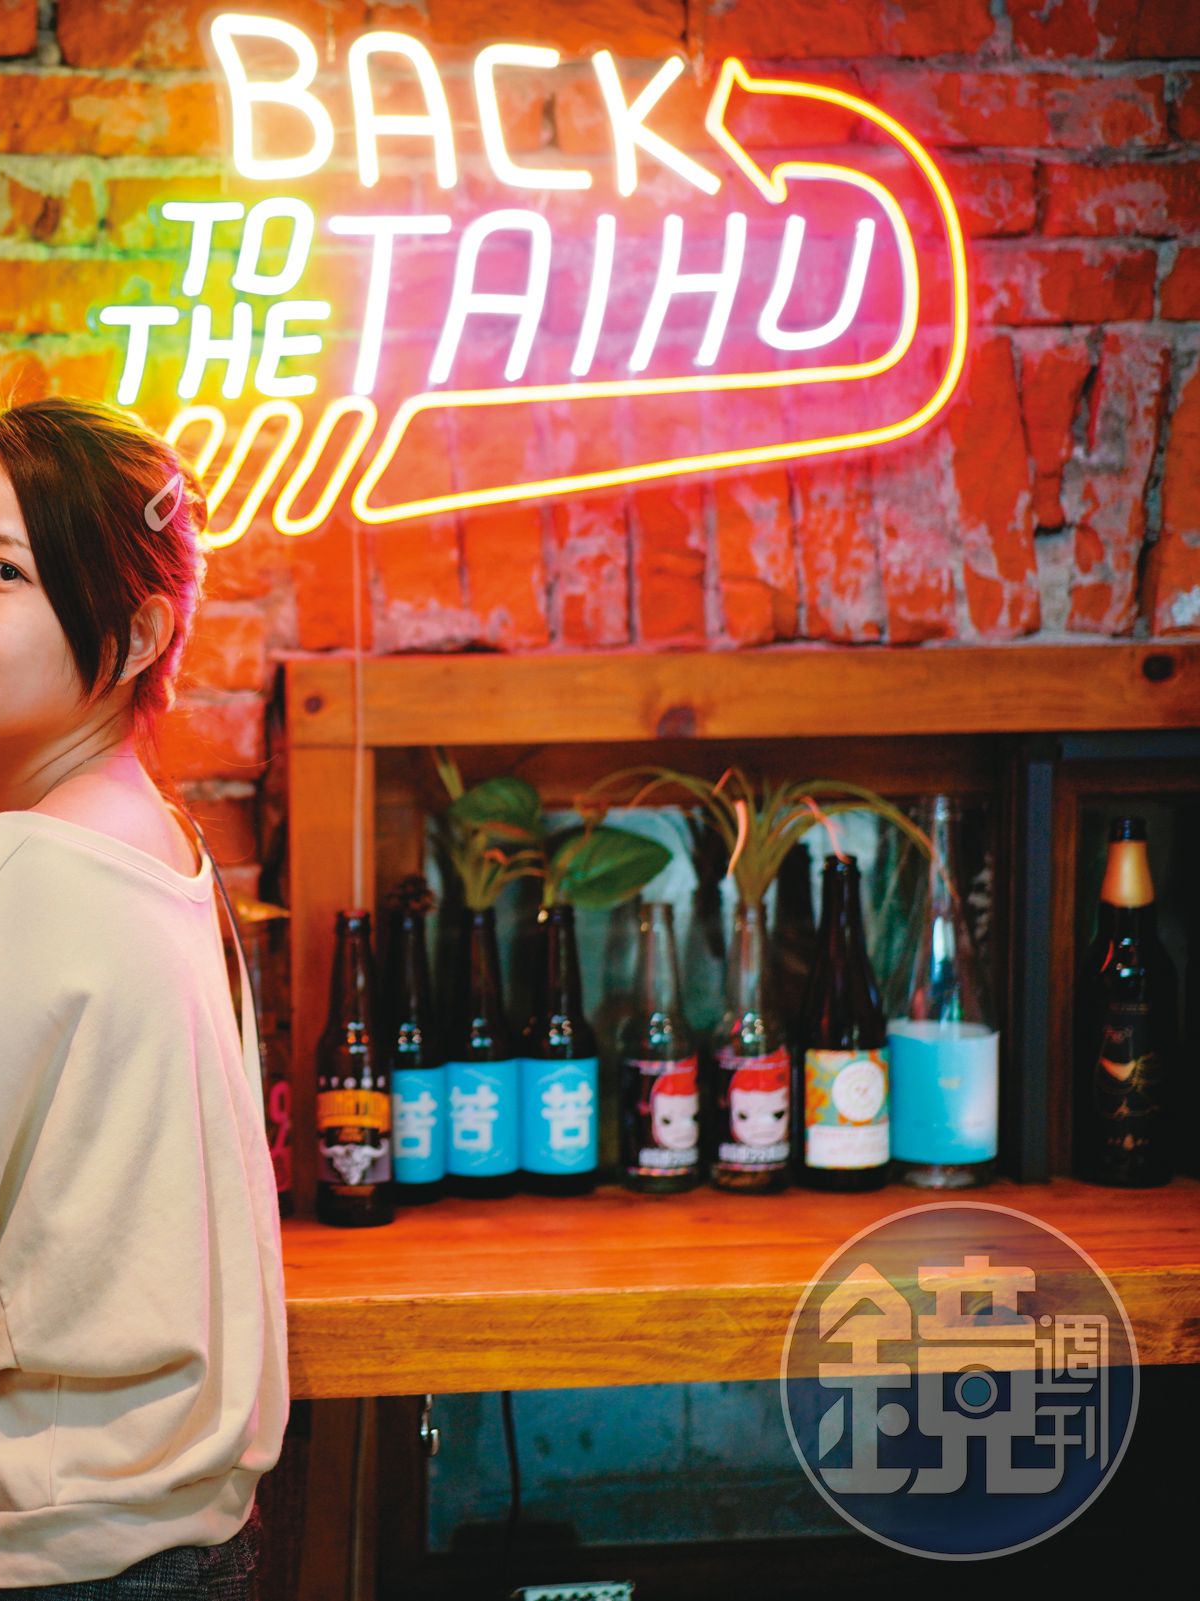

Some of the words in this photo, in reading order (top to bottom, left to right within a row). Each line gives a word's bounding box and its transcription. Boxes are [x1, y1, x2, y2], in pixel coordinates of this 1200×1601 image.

[210, 12, 721, 197] BACK
[162, 197, 313, 296] TO
[328, 208, 876, 396] TAIHU
[99, 301, 331, 404] THE
